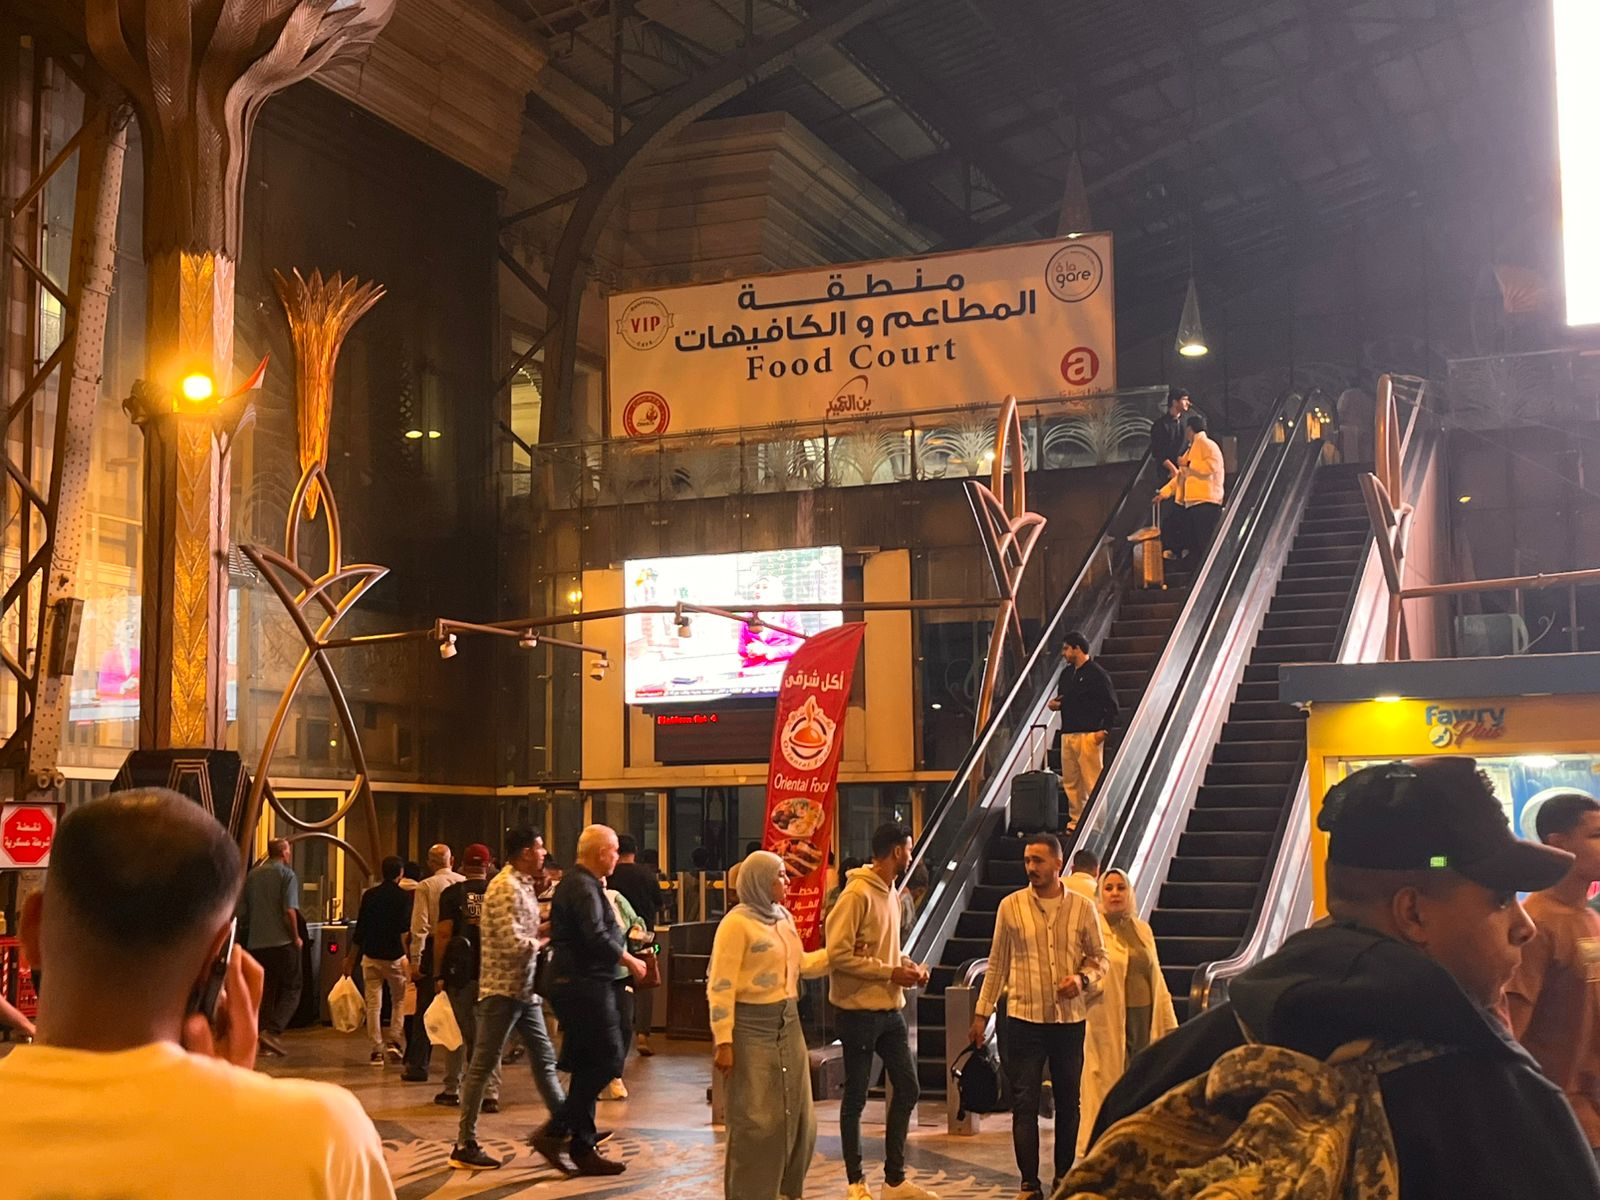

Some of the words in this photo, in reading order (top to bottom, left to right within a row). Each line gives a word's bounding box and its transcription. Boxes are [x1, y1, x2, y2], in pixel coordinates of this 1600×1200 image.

[737, 268, 965, 311] منطقة
[1056, 270, 1091, 289] gare
[630, 315, 661, 334] VIP
[882, 289, 1036, 337] المطاعم
[674, 310, 846, 352] الكافيهات
[856, 315, 874, 339] و
[745, 346, 833, 381] Food
[849, 338, 957, 370] Court
[820, 670, 845, 692] أكل
[1425, 705, 1505, 728] Fawry
[1453, 720, 1503, 749] Plus
[774, 772, 809, 792] Oriental
